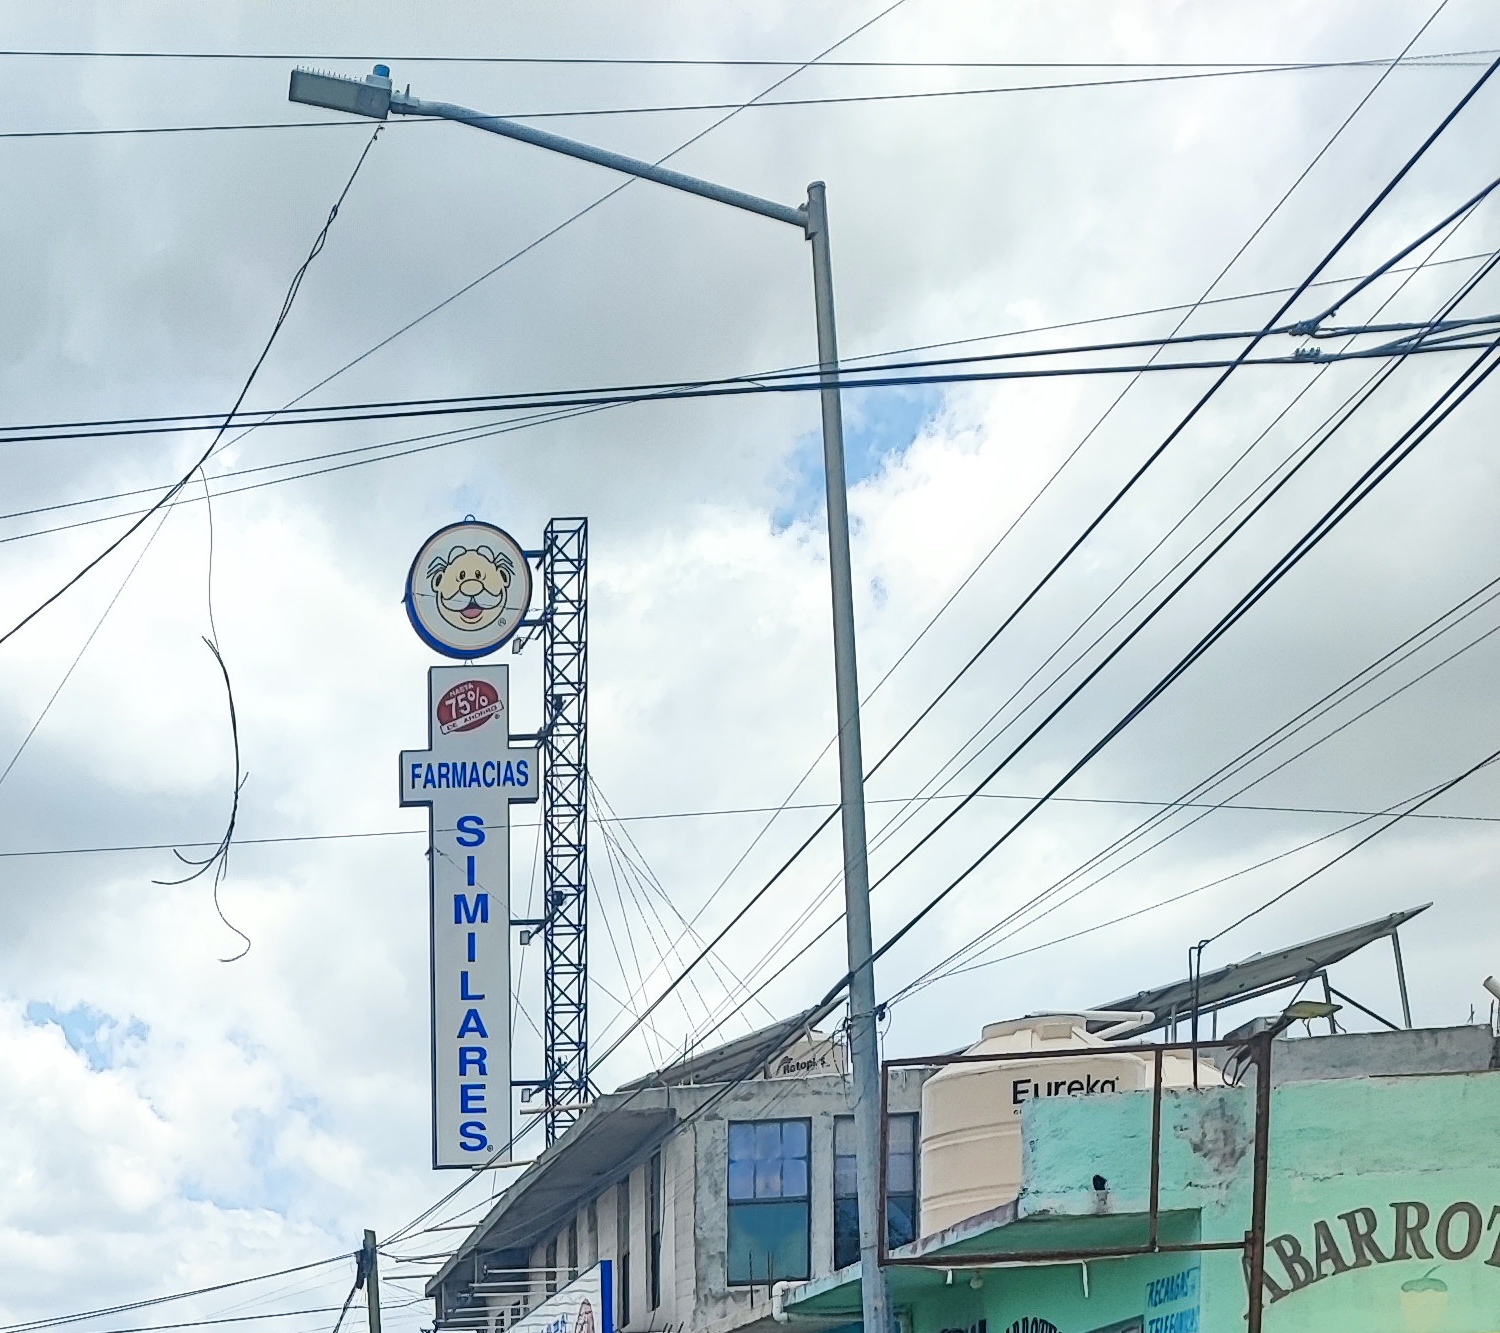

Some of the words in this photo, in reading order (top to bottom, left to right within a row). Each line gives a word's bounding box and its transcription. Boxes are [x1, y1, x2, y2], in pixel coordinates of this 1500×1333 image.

[445, 686, 489, 719] 75%
[449, 682, 474, 697] HASTA
[446, 721, 459, 731] DE
[411, 760, 529, 789] FARMACIAS
[453, 815, 489, 1152] SIMILARES
[1012, 1074, 1116, 1104] Eureka
[1146, 1270, 1189, 1308] RECARGAS
